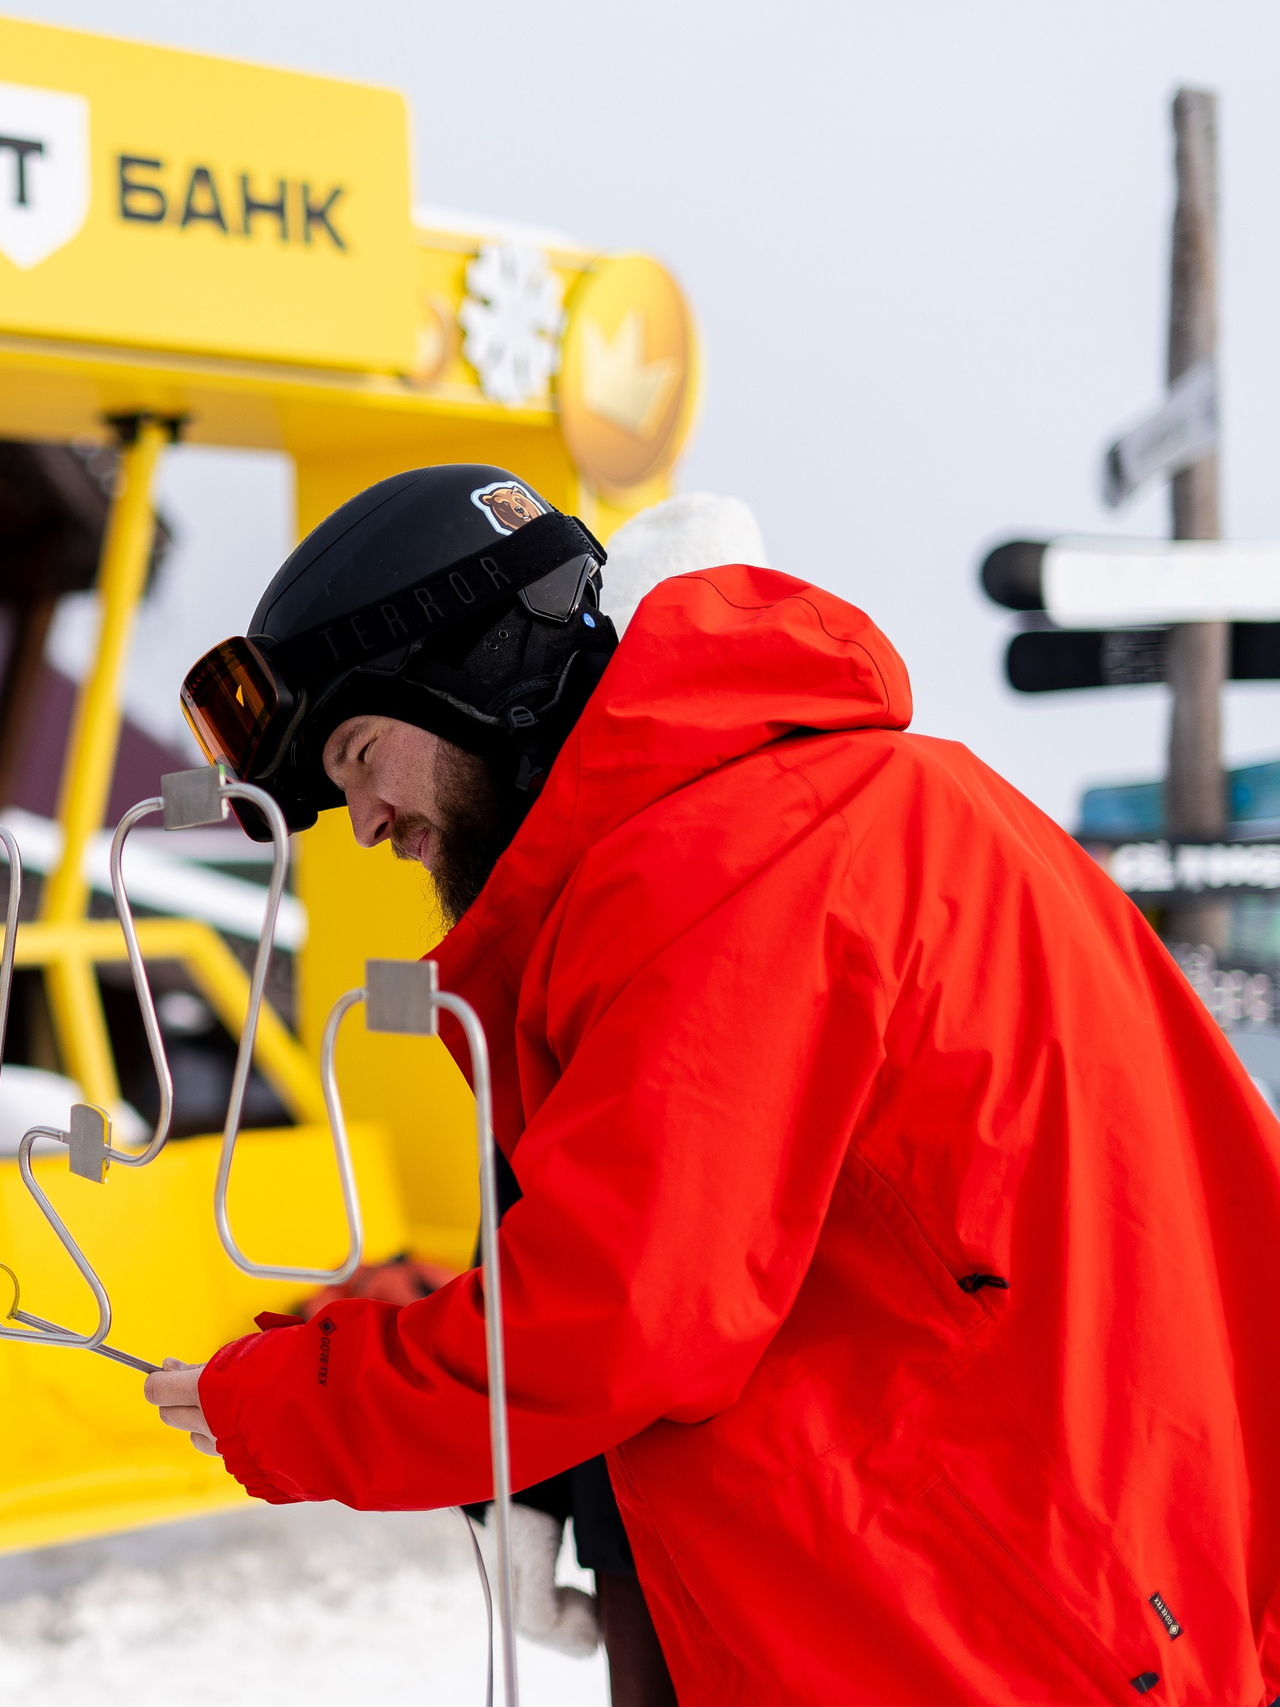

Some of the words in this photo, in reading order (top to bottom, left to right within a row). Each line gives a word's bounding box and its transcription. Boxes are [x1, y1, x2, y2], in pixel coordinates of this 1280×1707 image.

[119, 154, 348, 252] БАНК
[318, 556, 512, 662] TERROR
[318, 1337, 330, 1386] GORE-TEX
